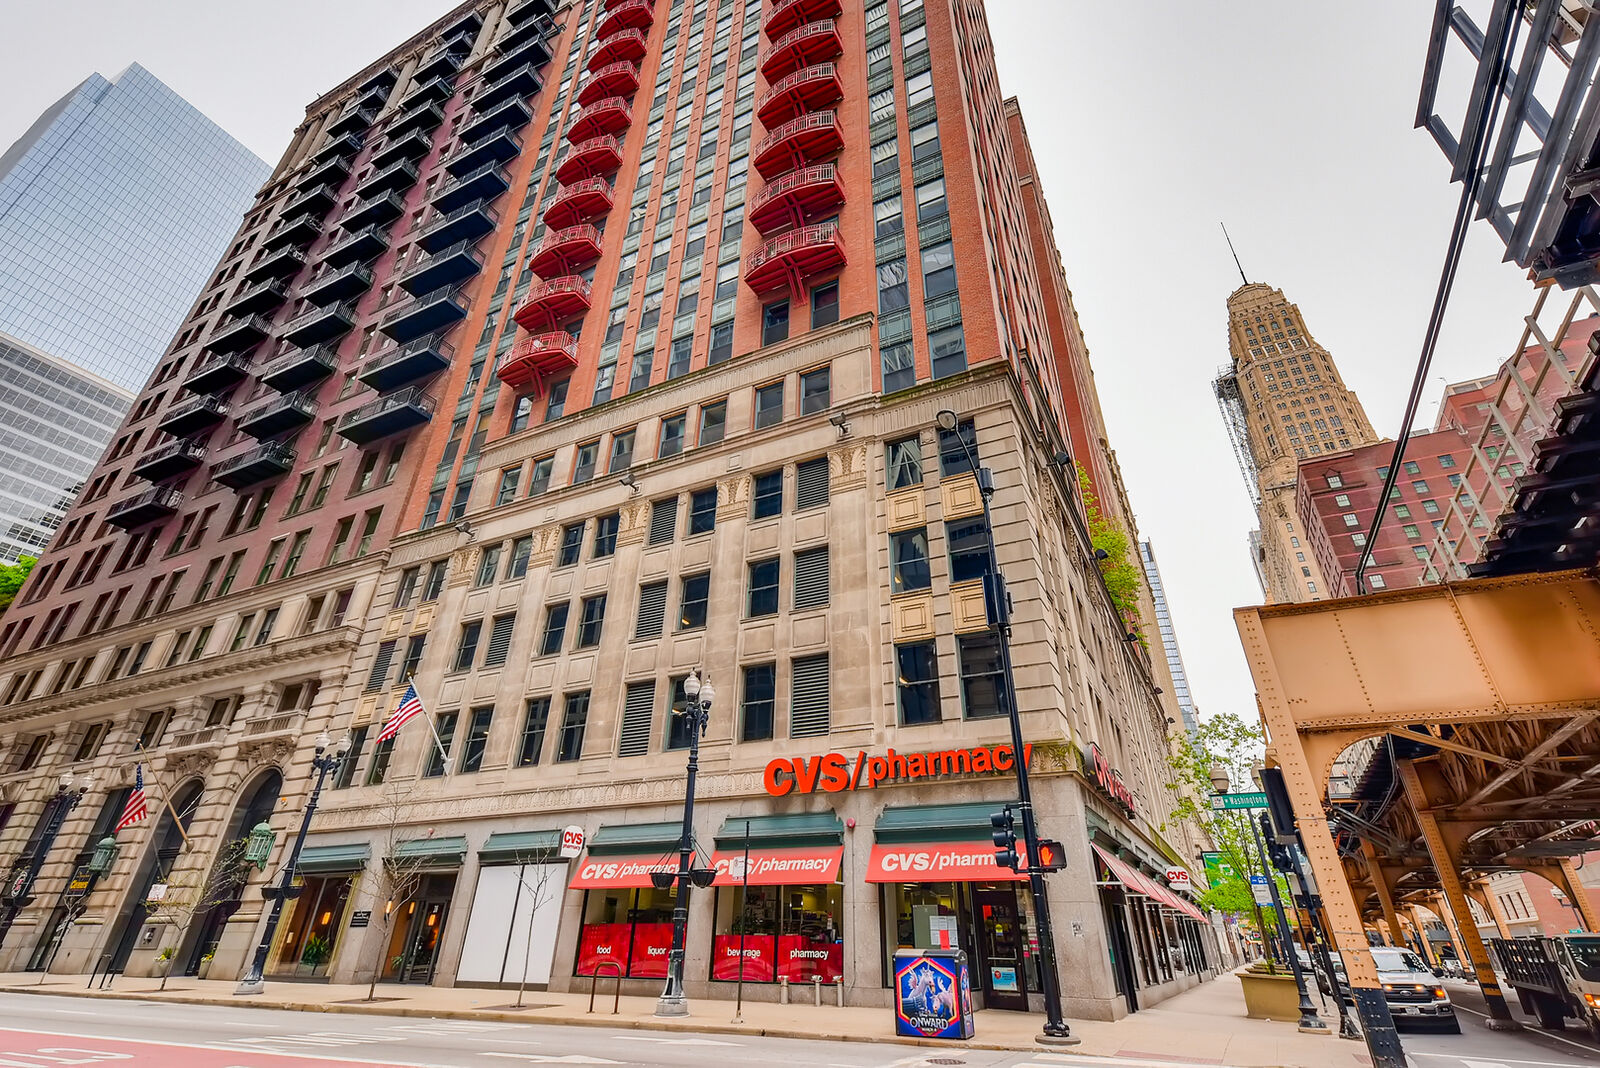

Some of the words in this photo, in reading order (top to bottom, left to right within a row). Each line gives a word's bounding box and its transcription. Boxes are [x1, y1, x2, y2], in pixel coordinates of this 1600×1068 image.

[1229, 796, 1263, 807] Washington
[564, 831, 583, 845] CVS
[881, 851, 1026, 872] CVS/pharmy
[1167, 871, 1189, 880] CVS
[596, 945, 612, 954] food
[647, 946, 667, 956] liquor
[790, 948, 829, 960] pharmacy
[910, 1017, 949, 1030] ONWARD
